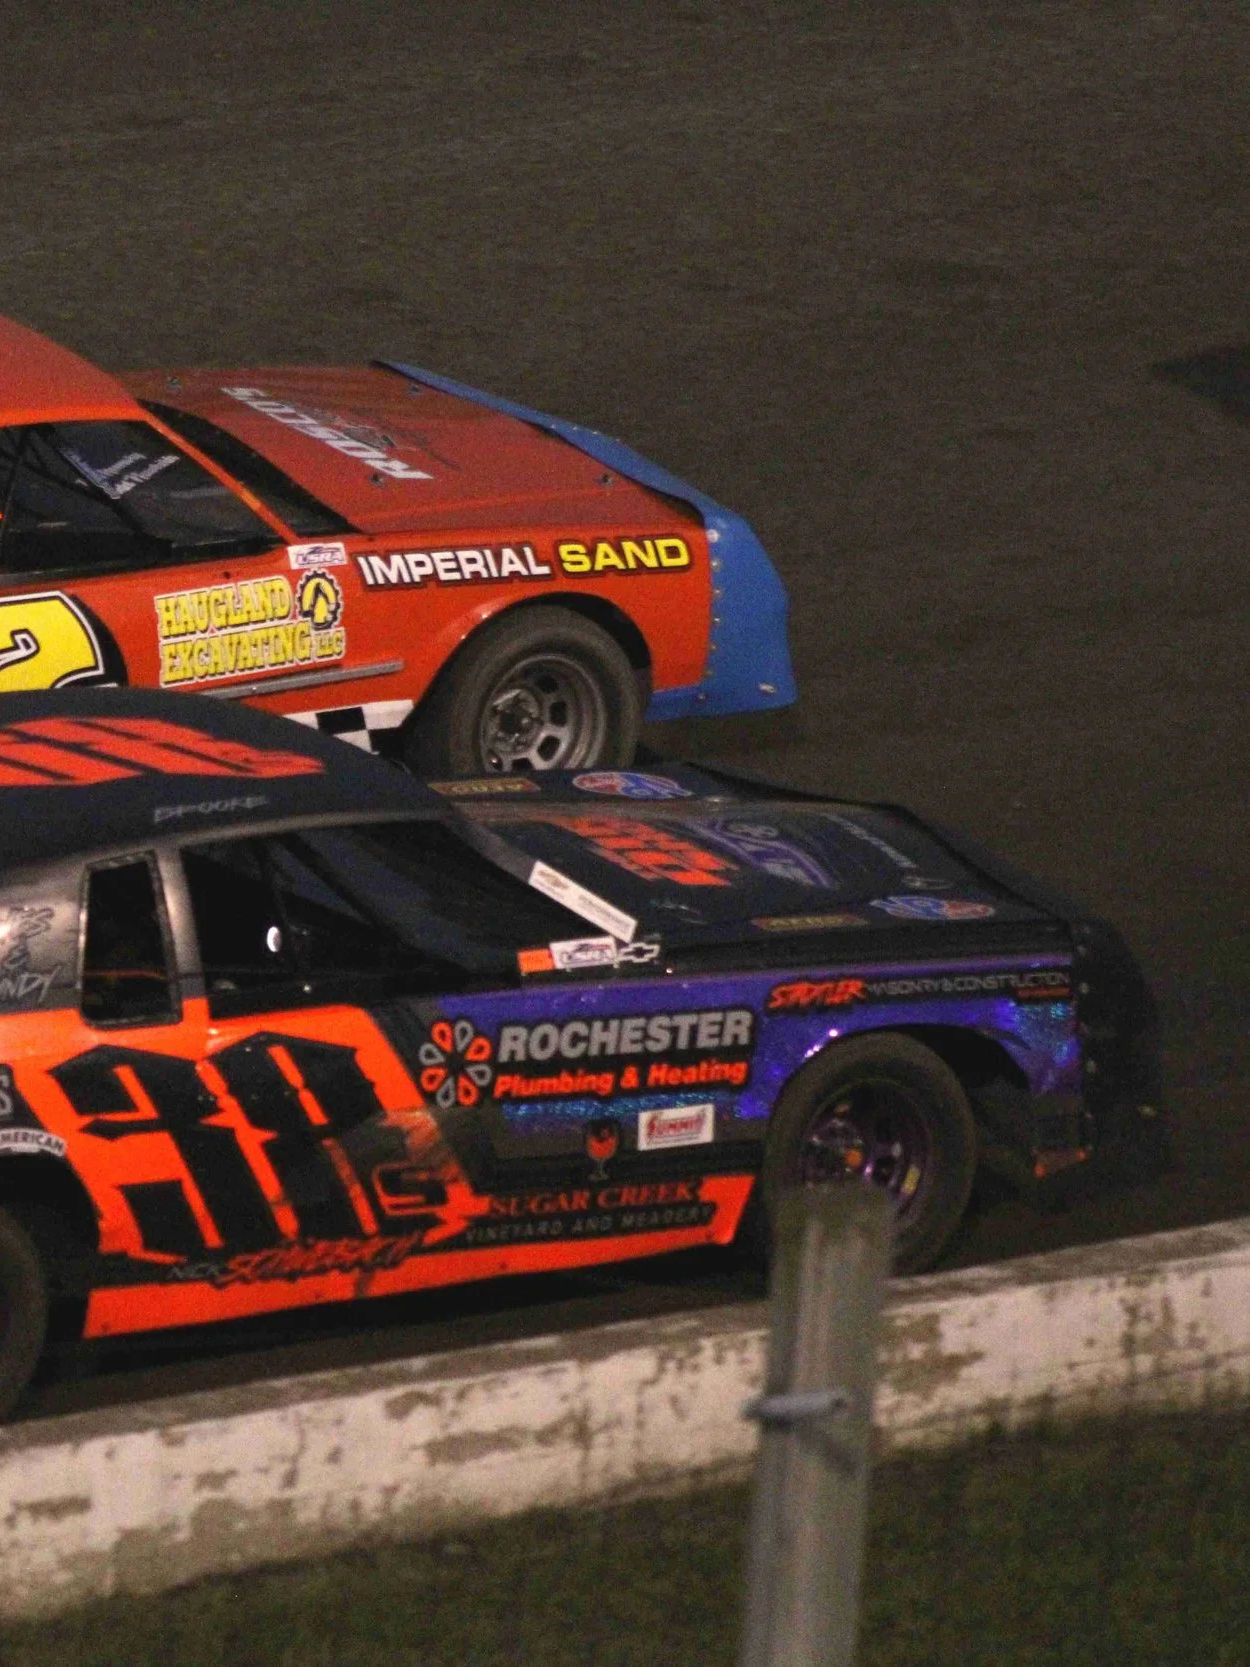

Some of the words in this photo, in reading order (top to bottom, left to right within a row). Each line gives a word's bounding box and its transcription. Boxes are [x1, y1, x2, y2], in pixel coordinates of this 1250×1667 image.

[357, 546, 551, 586] IMPERIAL
[558, 538, 689, 573] SAND
[157, 577, 294, 640] HAUGLAND
[161, 620, 312, 686] EXCAVATING
[313, 629, 345, 658] LLC
[497, 1010, 754, 1063] ROCHESTER
[493, 1070, 615, 1099] Plumbing
[619, 1065, 640, 1089] &
[646, 1058, 748, 1087] Heating
[490, 1188, 590, 1217] SUGAR
[597, 1182, 693, 1209] CREEK
[464, 1218, 563, 1244] VINEYARD
[571, 1214, 614, 1234] AND
[620, 1205, 713, 1229] MEADERY
